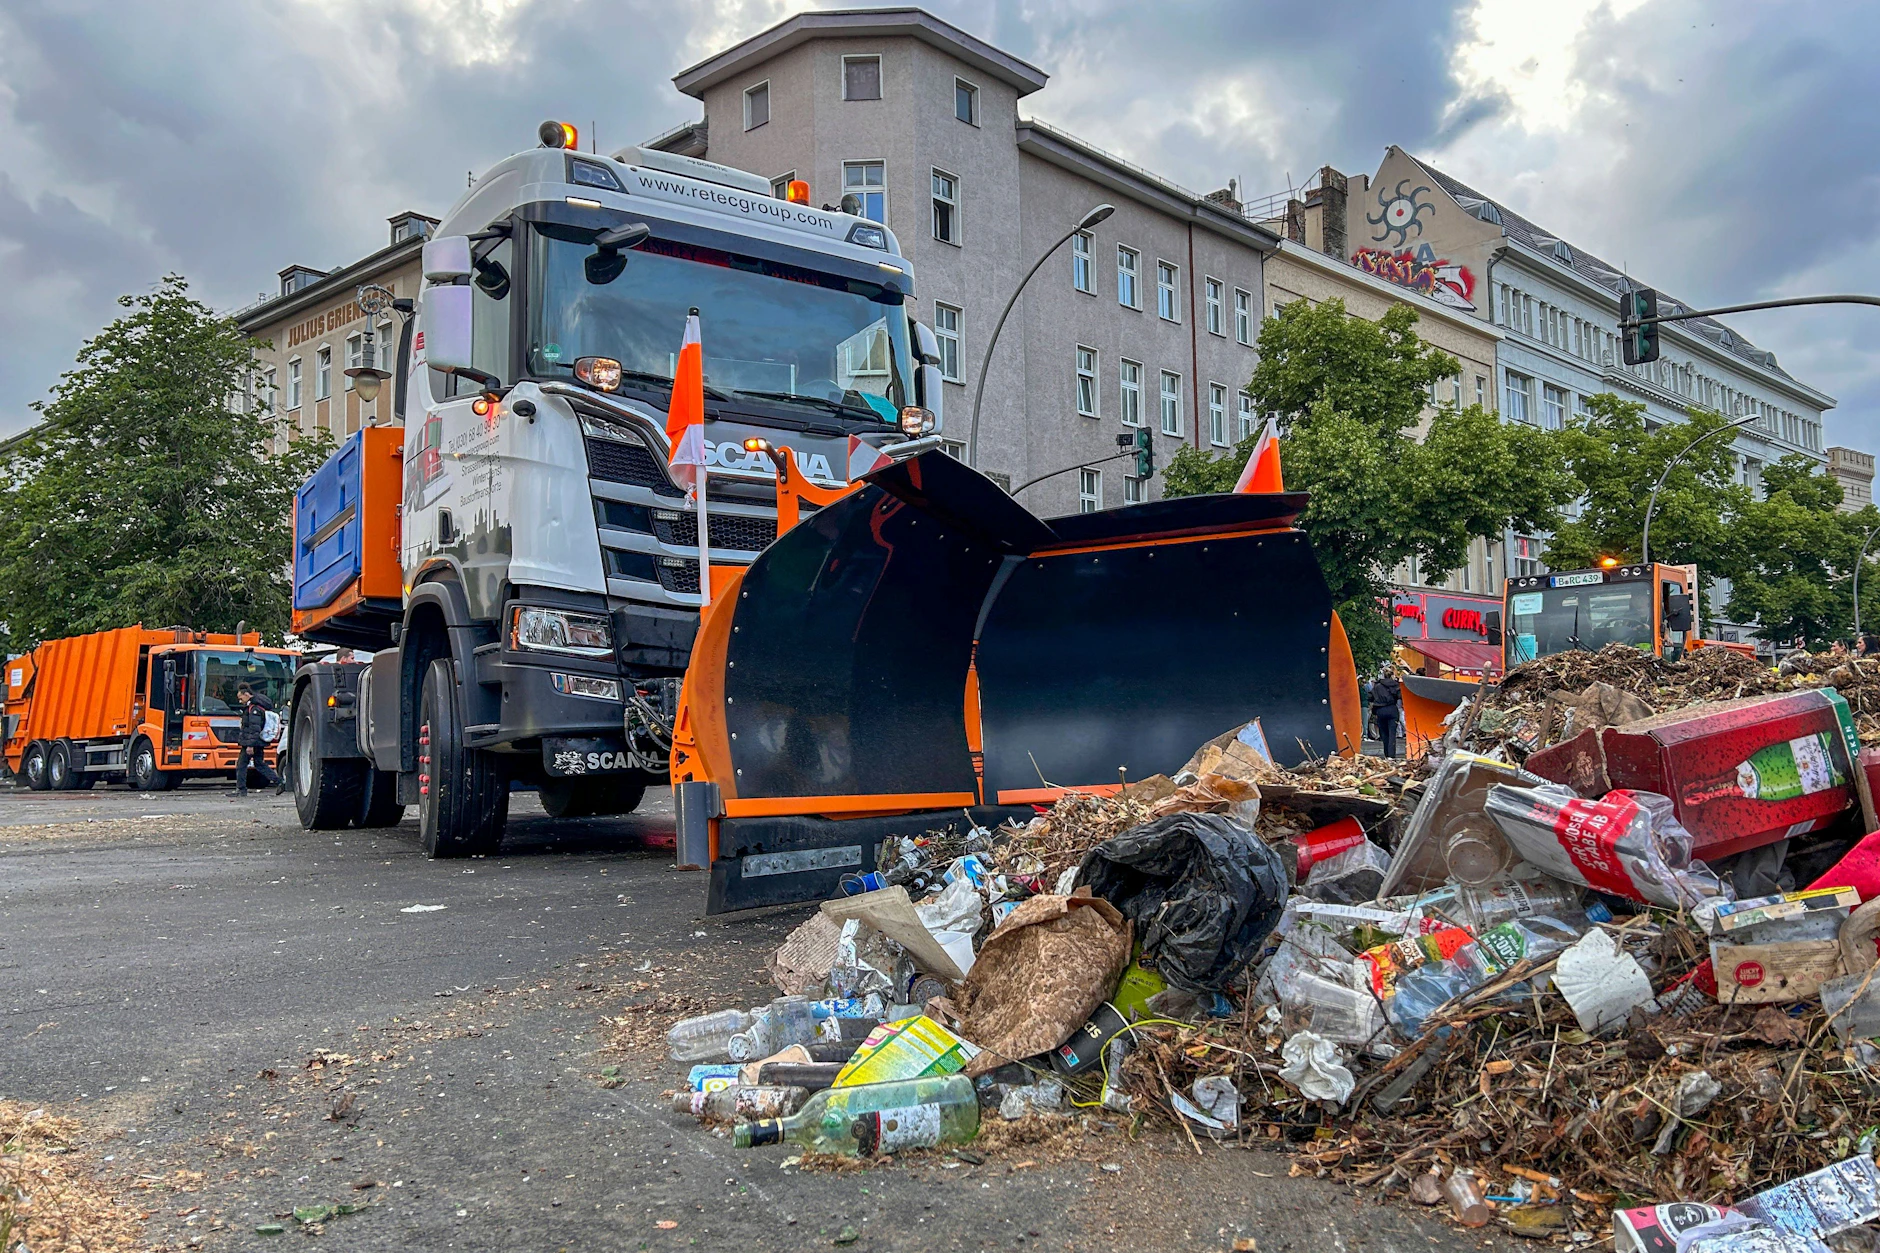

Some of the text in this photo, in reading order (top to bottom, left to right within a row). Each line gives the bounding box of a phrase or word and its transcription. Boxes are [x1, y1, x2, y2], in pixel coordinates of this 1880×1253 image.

[638, 175, 834, 231] www.retecgroup.com
[287, 314, 325, 349] JULIUS
[1558, 574, 1599, 586] B RC 439
[1442, 606, 1482, 633] CURRY
[1588, 814, 1609, 830] AB
[1400, 940, 1416, 965] BOX
